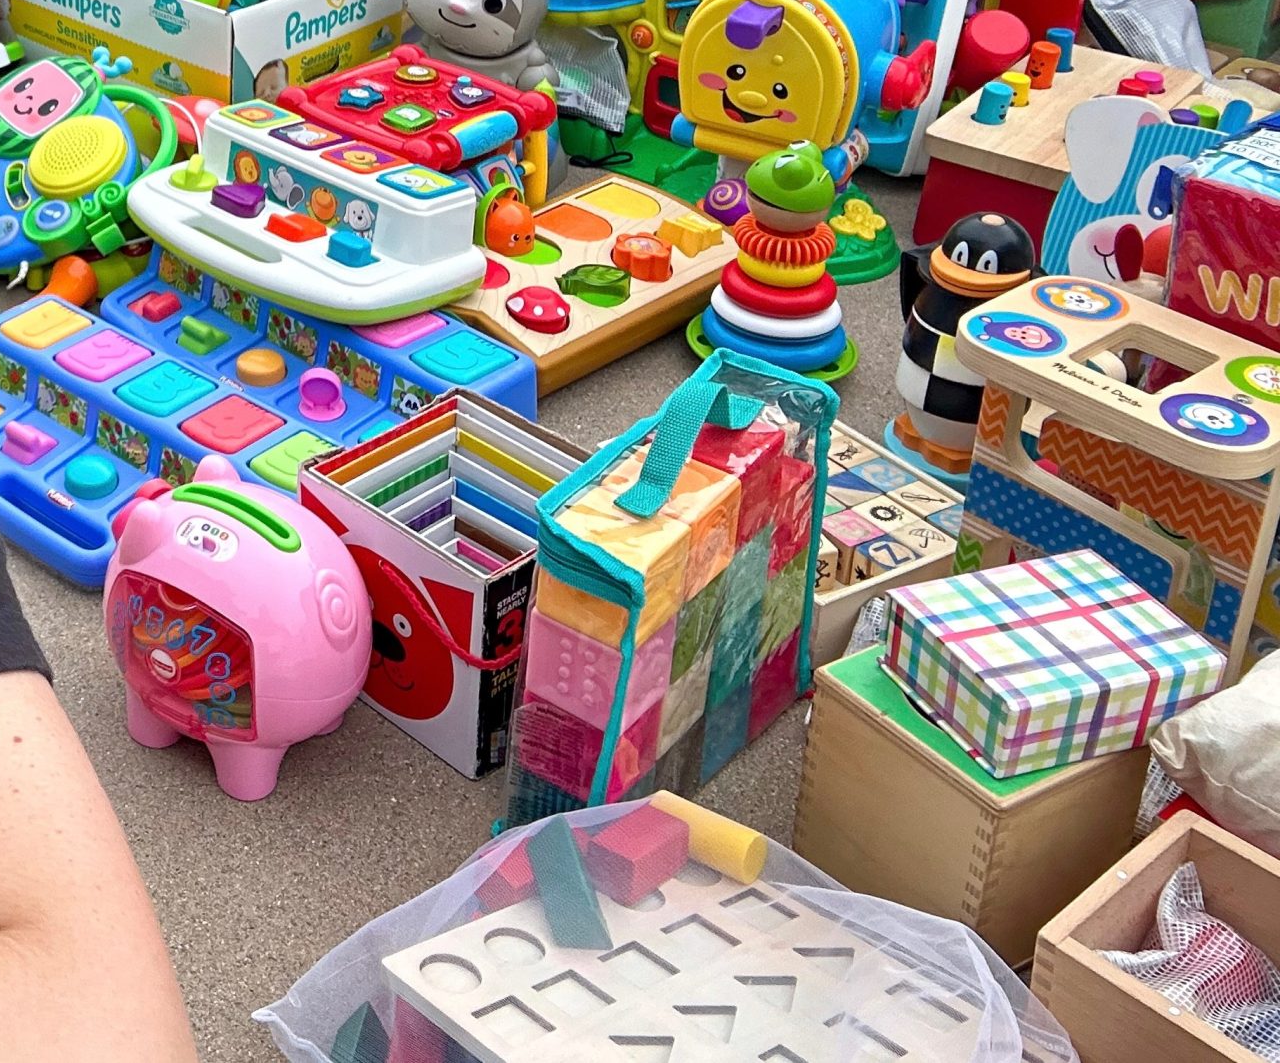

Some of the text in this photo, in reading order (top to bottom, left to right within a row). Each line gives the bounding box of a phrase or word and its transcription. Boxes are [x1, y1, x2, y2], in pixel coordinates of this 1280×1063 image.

[56, 20, 110, 48] Sensitive
[301, 41, 351, 67] Sensitive
[496, 586, 528, 610] STACKS
[496, 595, 527, 620] NEARLY
[495, 608, 524, 658] 3
[190, 625, 217, 656] 7
[205, 652, 232, 680] 8
